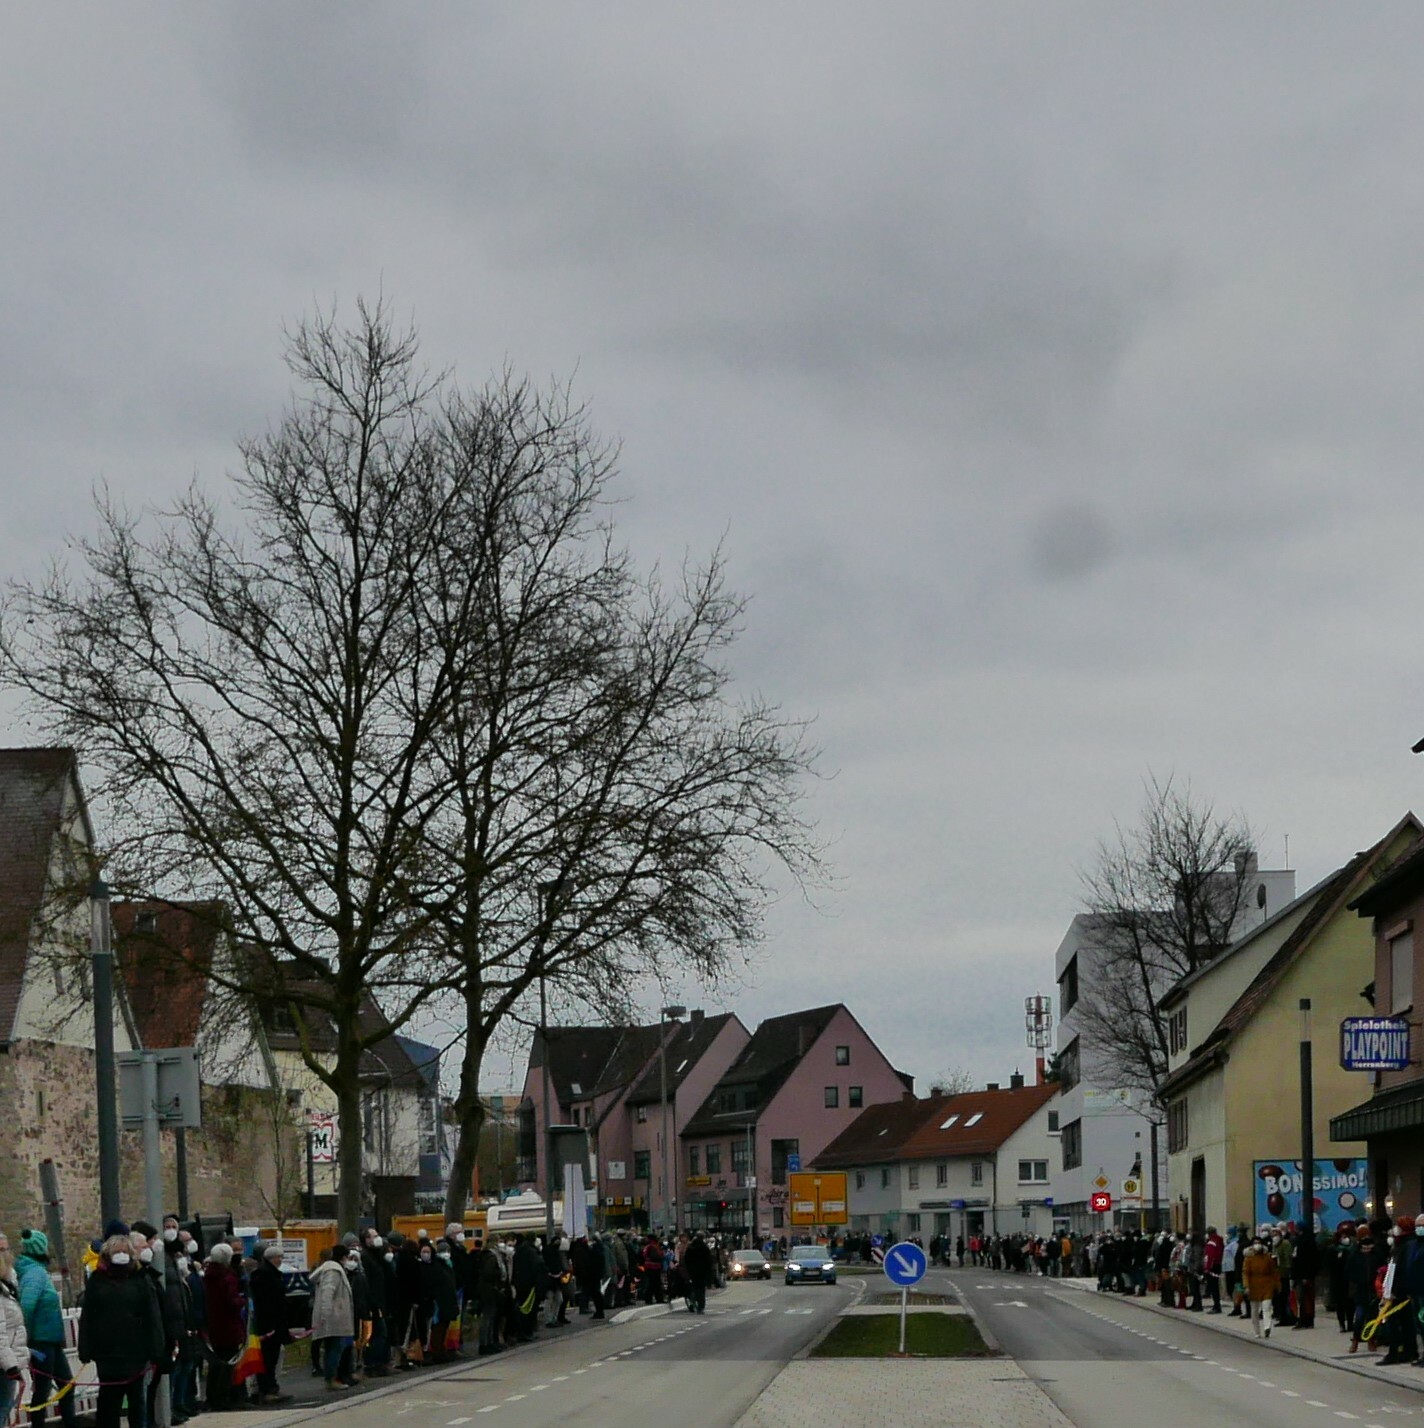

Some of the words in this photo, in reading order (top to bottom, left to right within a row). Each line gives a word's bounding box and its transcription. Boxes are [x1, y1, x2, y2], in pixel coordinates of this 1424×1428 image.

[1344, 1032, 1408, 1060] PLAYPOINT
[1265, 1168, 1365, 1195] BONSSIMO!
[1096, 1198, 1107, 1206] 30
